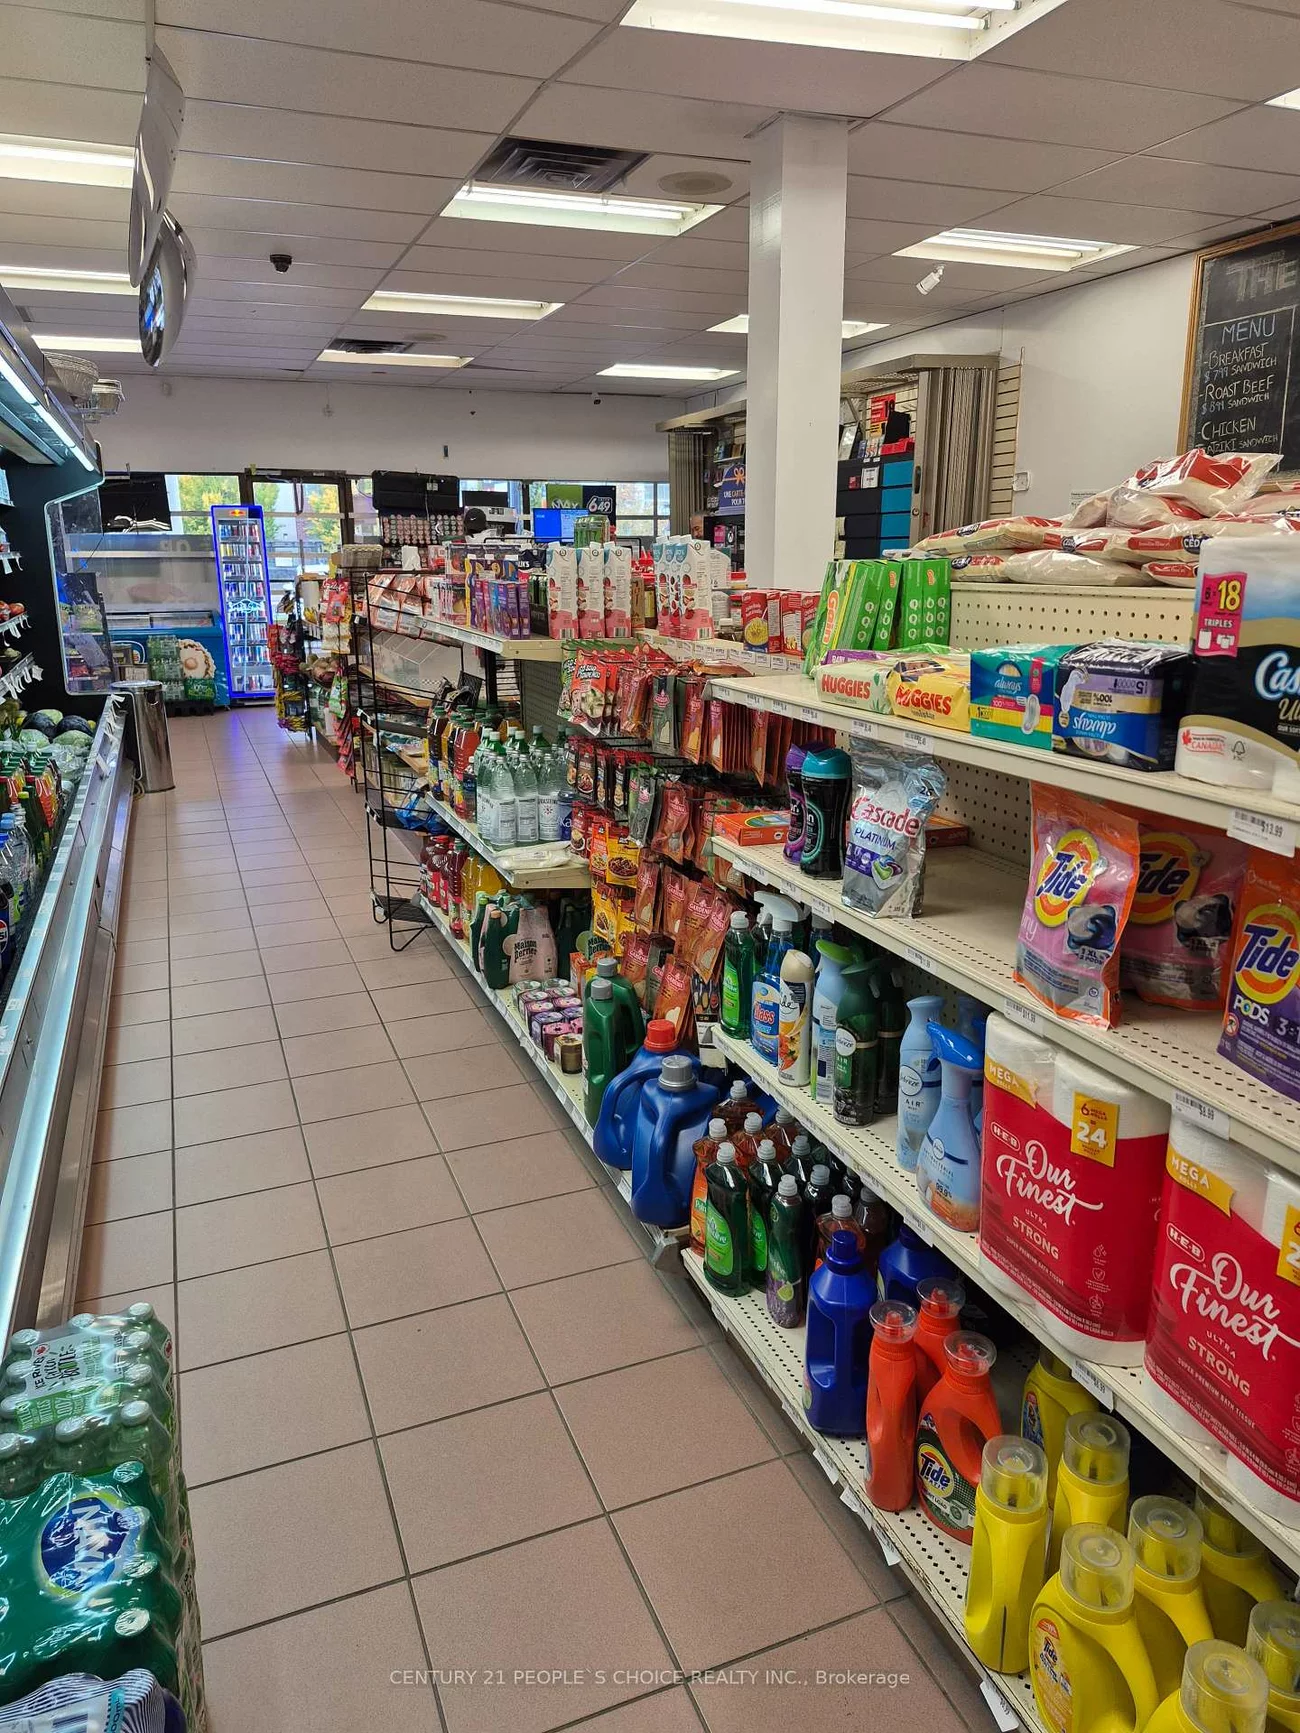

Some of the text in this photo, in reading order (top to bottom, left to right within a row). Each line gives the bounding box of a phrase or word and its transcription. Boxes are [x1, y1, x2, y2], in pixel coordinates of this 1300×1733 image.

[1226, 256, 1298, 302] THE
[1221, 313, 1276, 345] MENU
[1231, 356, 1277, 376] SANDWICH
[1242, 374, 1275, 395] BEEF
[1228, 392, 1270, 409] SANDWICH
[1239, 433, 1279, 449] SANDWICH
[1218, 579, 1242, 612] 18
[1204, 617, 1234, 629] TRIPLES
[821, 673, 872, 700] HUGGIES
[994, 676, 1023, 695] always
[1073, 712, 1117, 739] always
[851, 796, 921, 836] Cascade
[855, 827, 897, 851] PLATINUM
[1036, 852, 1088, 900] Tide
[1235, 923, 1300, 978] Tide
[1233, 994, 1271, 1026] PODS
[989, 1063, 1020, 1089] MEGA
[905, 1098, 921, 1107] AIR
[1080, 1103, 1090, 1117] 6
[1076, 1121, 1108, 1150] 24
[1024, 1139, 1077, 1191] Our
[1171, 1156, 1211, 1190] MEGA
[996, 1154, 1104, 1227] Finest
[1025, 1208, 1048, 1229] ULTRA
[1012, 1215, 1060, 1260] STRONG
[1211, 1252, 1281, 1320] Our
[1169, 1262, 1300, 1361] Finest
[1206, 1330, 1236, 1359] ULTRA
[1187, 1335, 1251, 1398] STRONG
[920, 1452, 951, 1489] Tide
